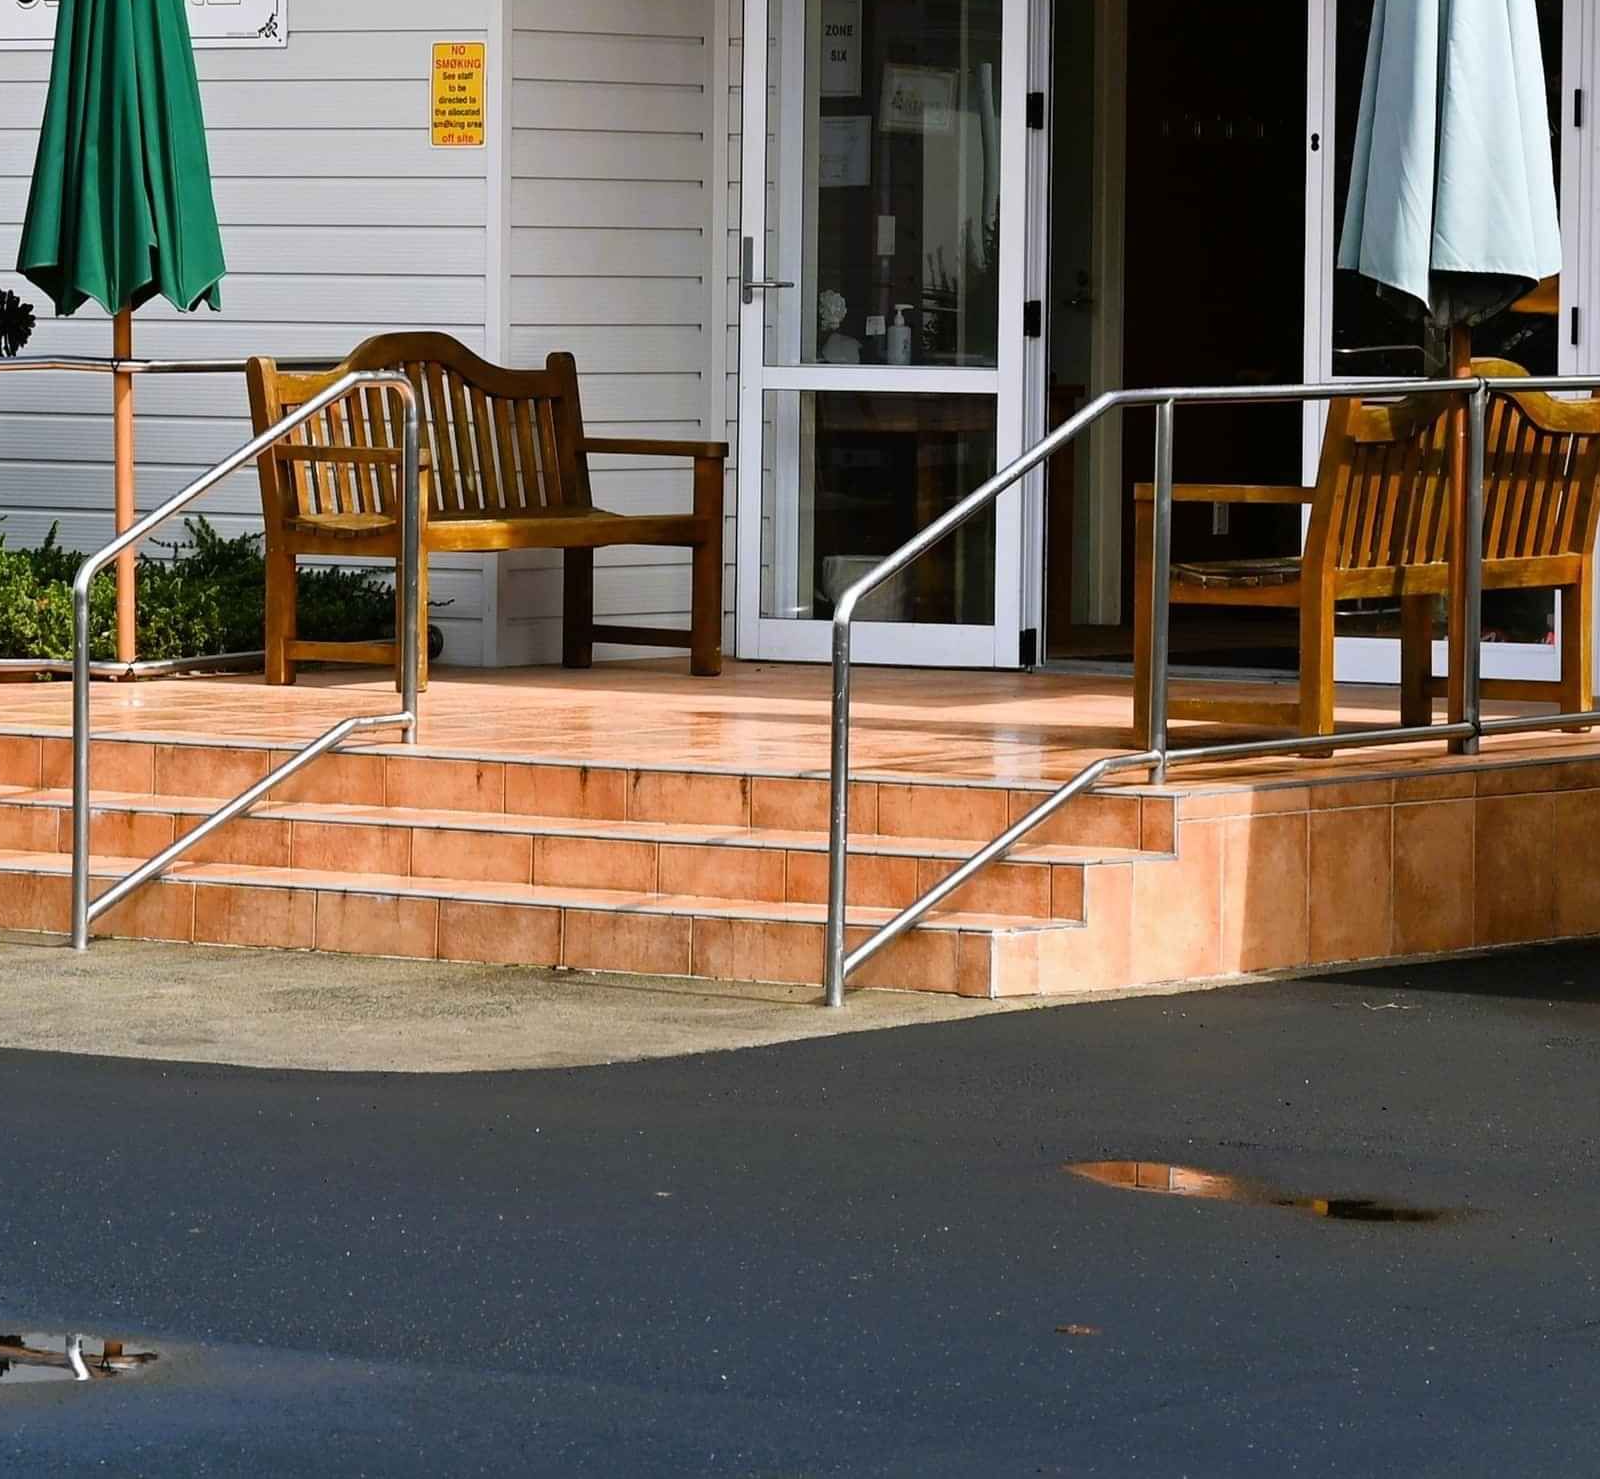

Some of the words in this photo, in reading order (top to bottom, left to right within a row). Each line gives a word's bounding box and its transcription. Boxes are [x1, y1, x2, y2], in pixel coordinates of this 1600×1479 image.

[825, 24, 853, 36] ZONE
[451, 45, 466, 56] NO
[830, 50, 847, 62] SIX
[435, 59, 481, 69] SMOKING
